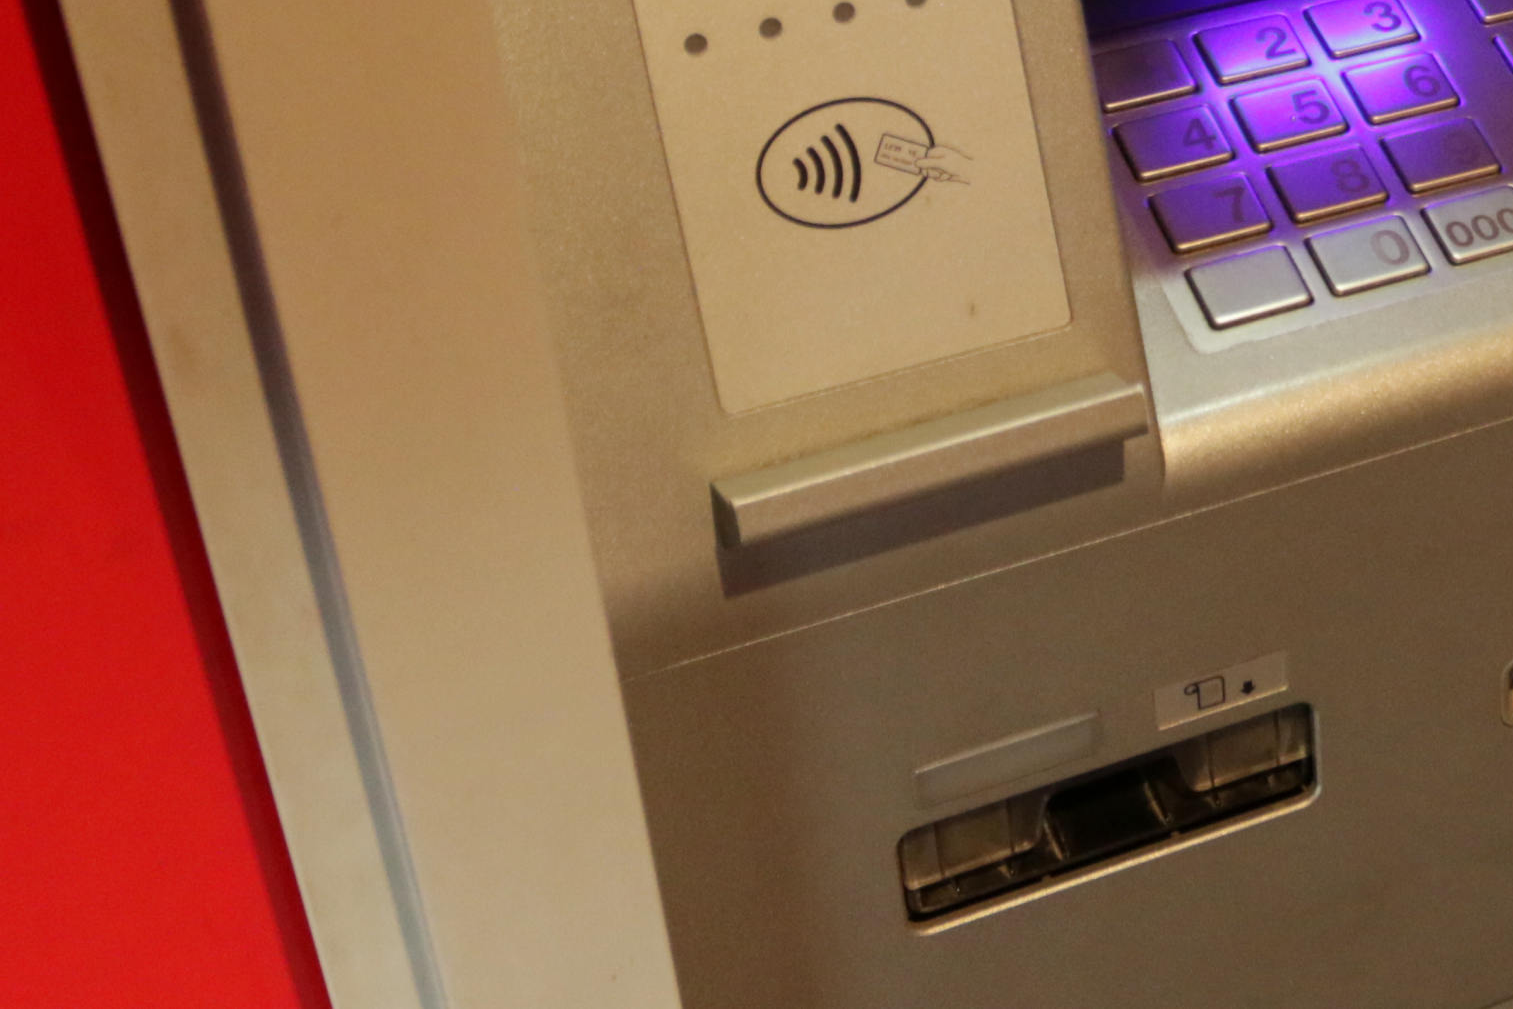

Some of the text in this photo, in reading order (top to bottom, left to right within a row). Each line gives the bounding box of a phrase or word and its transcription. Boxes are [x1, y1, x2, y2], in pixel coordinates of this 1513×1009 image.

[1364, 2, 1402, 32] 3
[1256, 27, 1296, 59] 2
[1404, 64, 1441, 97] 6
[1292, 91, 1330, 124] 5
[1183, 117, 1217, 151] 4
[1331, 157, 1370, 190] 8
[1214, 187, 1246, 223] 7
[1371, 230, 1411, 265] 0
